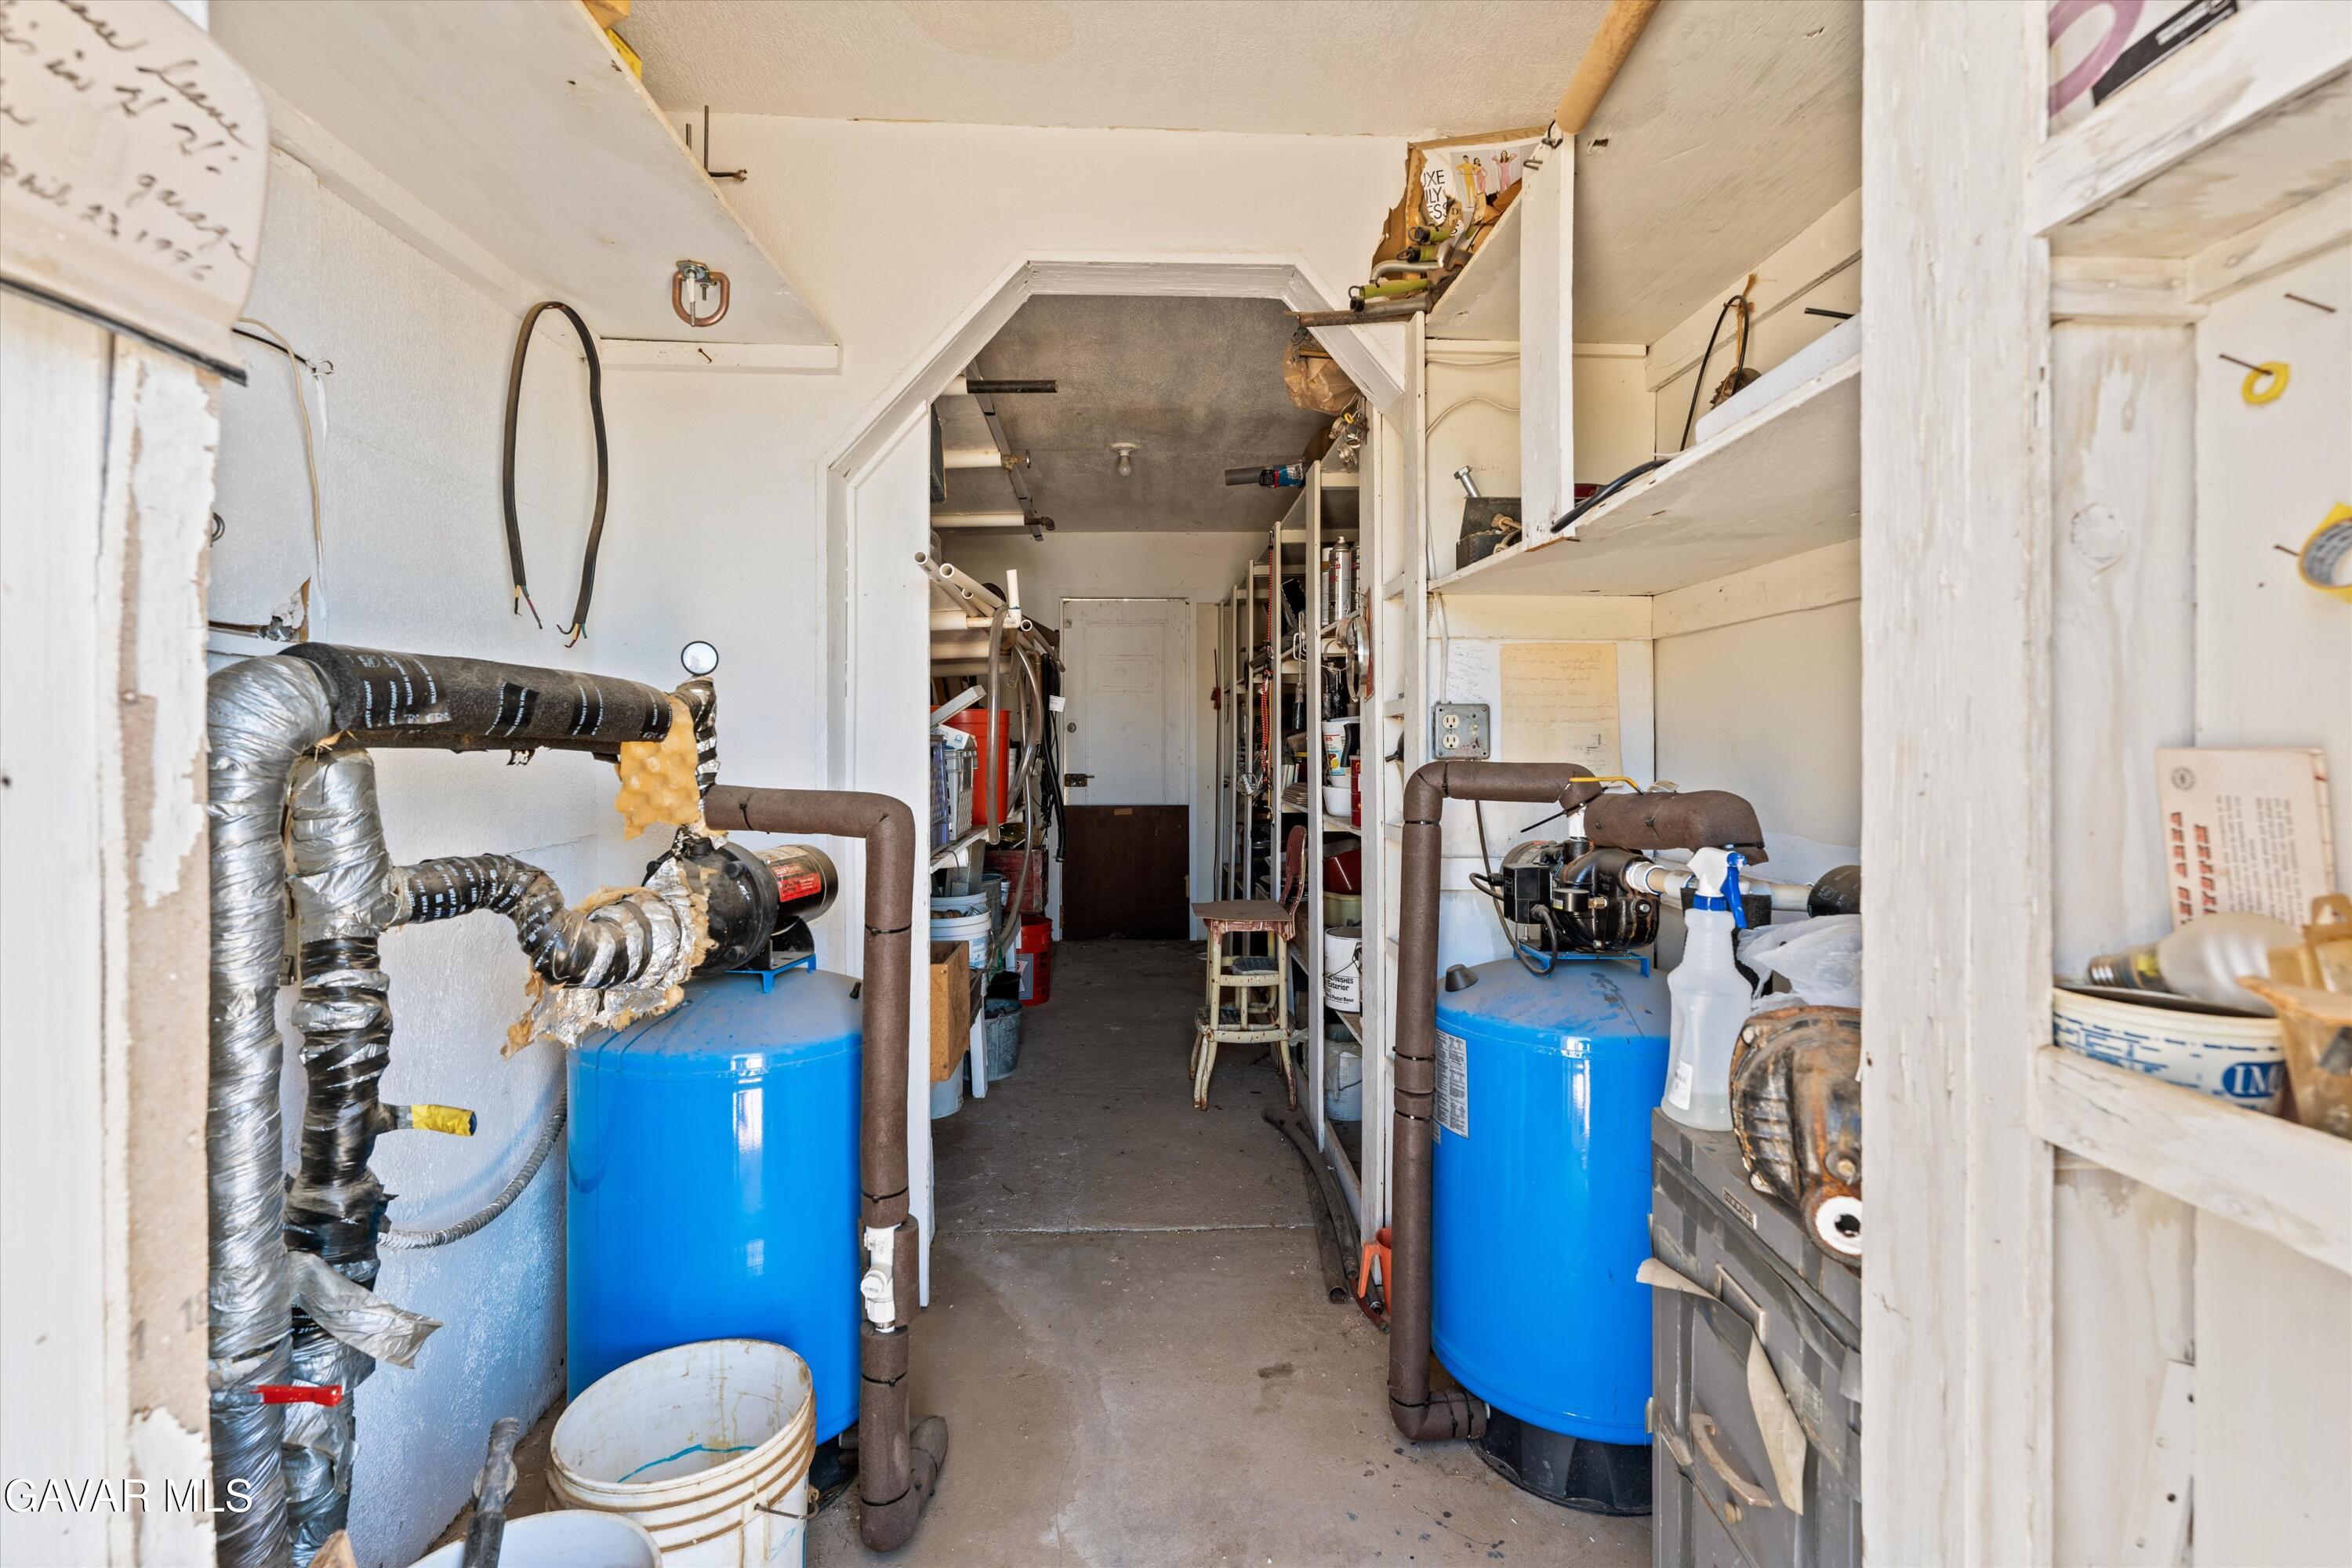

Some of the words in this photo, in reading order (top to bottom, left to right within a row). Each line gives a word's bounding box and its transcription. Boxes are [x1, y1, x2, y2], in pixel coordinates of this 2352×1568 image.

[363, 680, 372, 710] COMPANY
[389, 680, 397, 709] COMPANY
[404, 681, 413, 706] WILLIAM
[427, 680, 437, 704] WILLIAM
[448, 887, 457, 906] WRAP
[1327, 980, 1350, 991] Exterior
